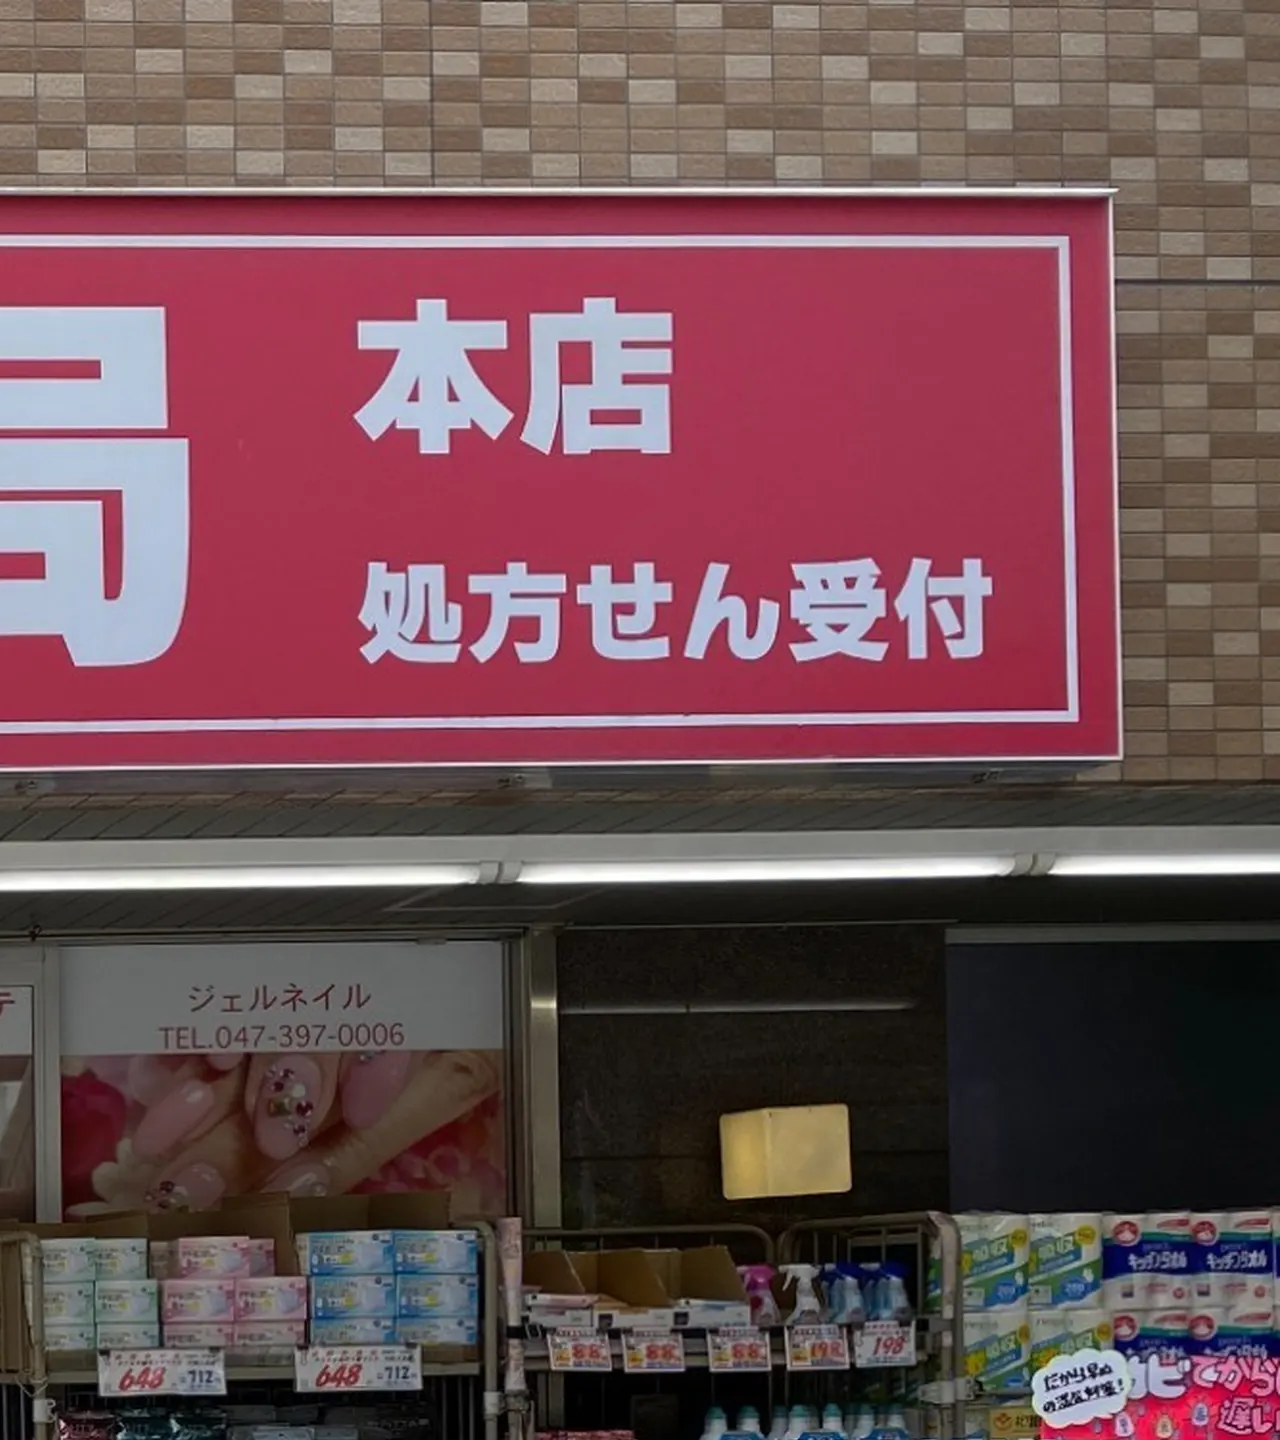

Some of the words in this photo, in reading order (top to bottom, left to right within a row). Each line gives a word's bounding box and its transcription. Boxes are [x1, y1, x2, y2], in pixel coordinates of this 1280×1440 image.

[353, 297, 673, 454] 本店
[357, 557, 993, 665] 処方せん受付
[188, 982, 372, 1013] ジェルネイル
[158, 1022, 406, 1051] TEL.047-397-0006
[118, 1366, 167, 1392] 648
[187, 1369, 214, 1385] 712
[314, 1362, 363, 1388] 648
[383, 1365, 408, 1381] 712
